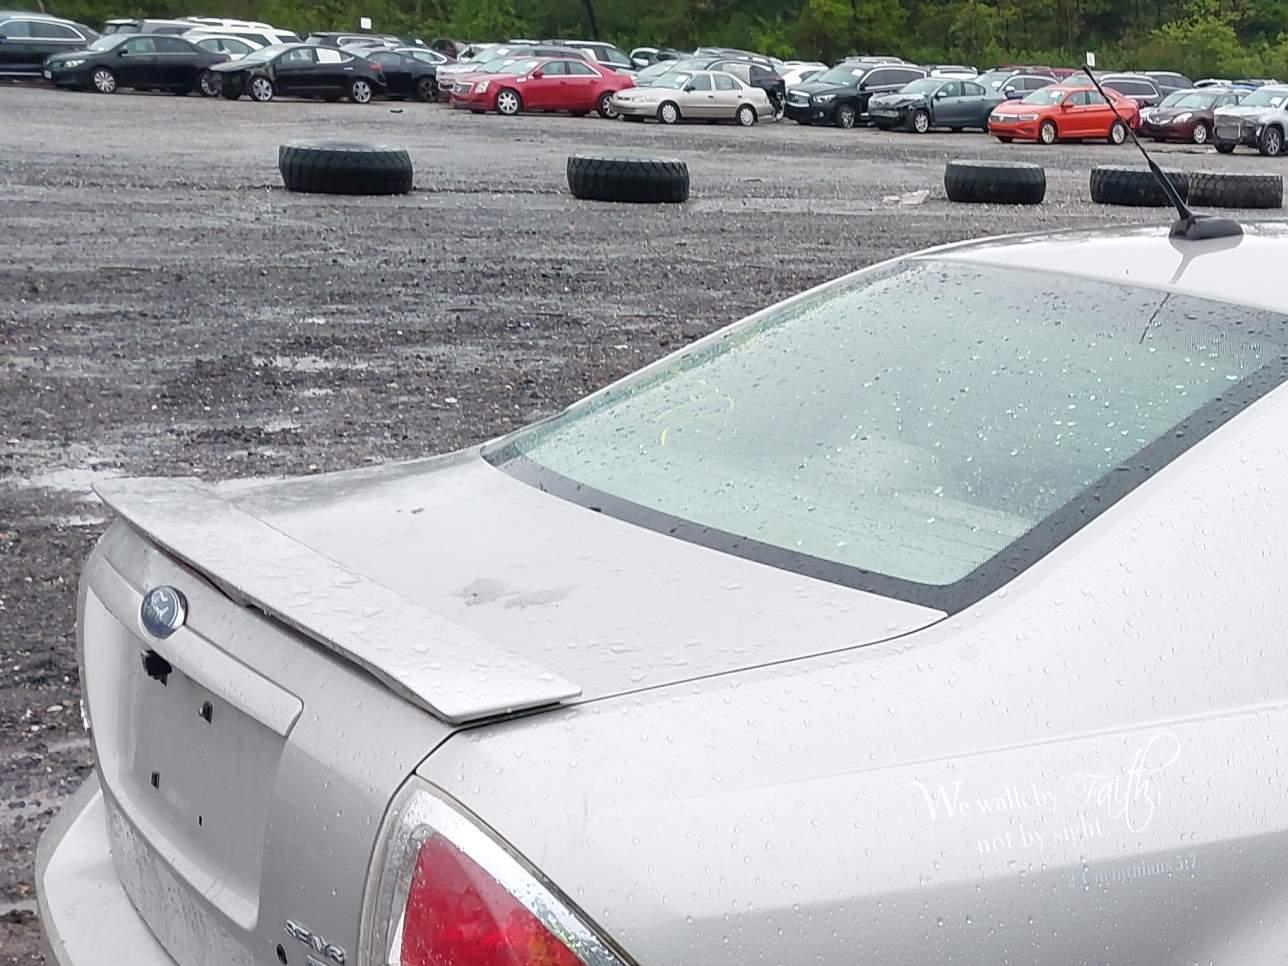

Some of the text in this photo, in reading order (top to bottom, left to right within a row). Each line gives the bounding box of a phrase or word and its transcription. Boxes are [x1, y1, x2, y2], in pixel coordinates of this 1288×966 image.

[906, 781, 970, 823] We
[975, 785, 1029, 815] walk
[1030, 783, 1057, 815] by
[976, 830, 1013, 853] not
[1018, 822, 1044, 854] by
